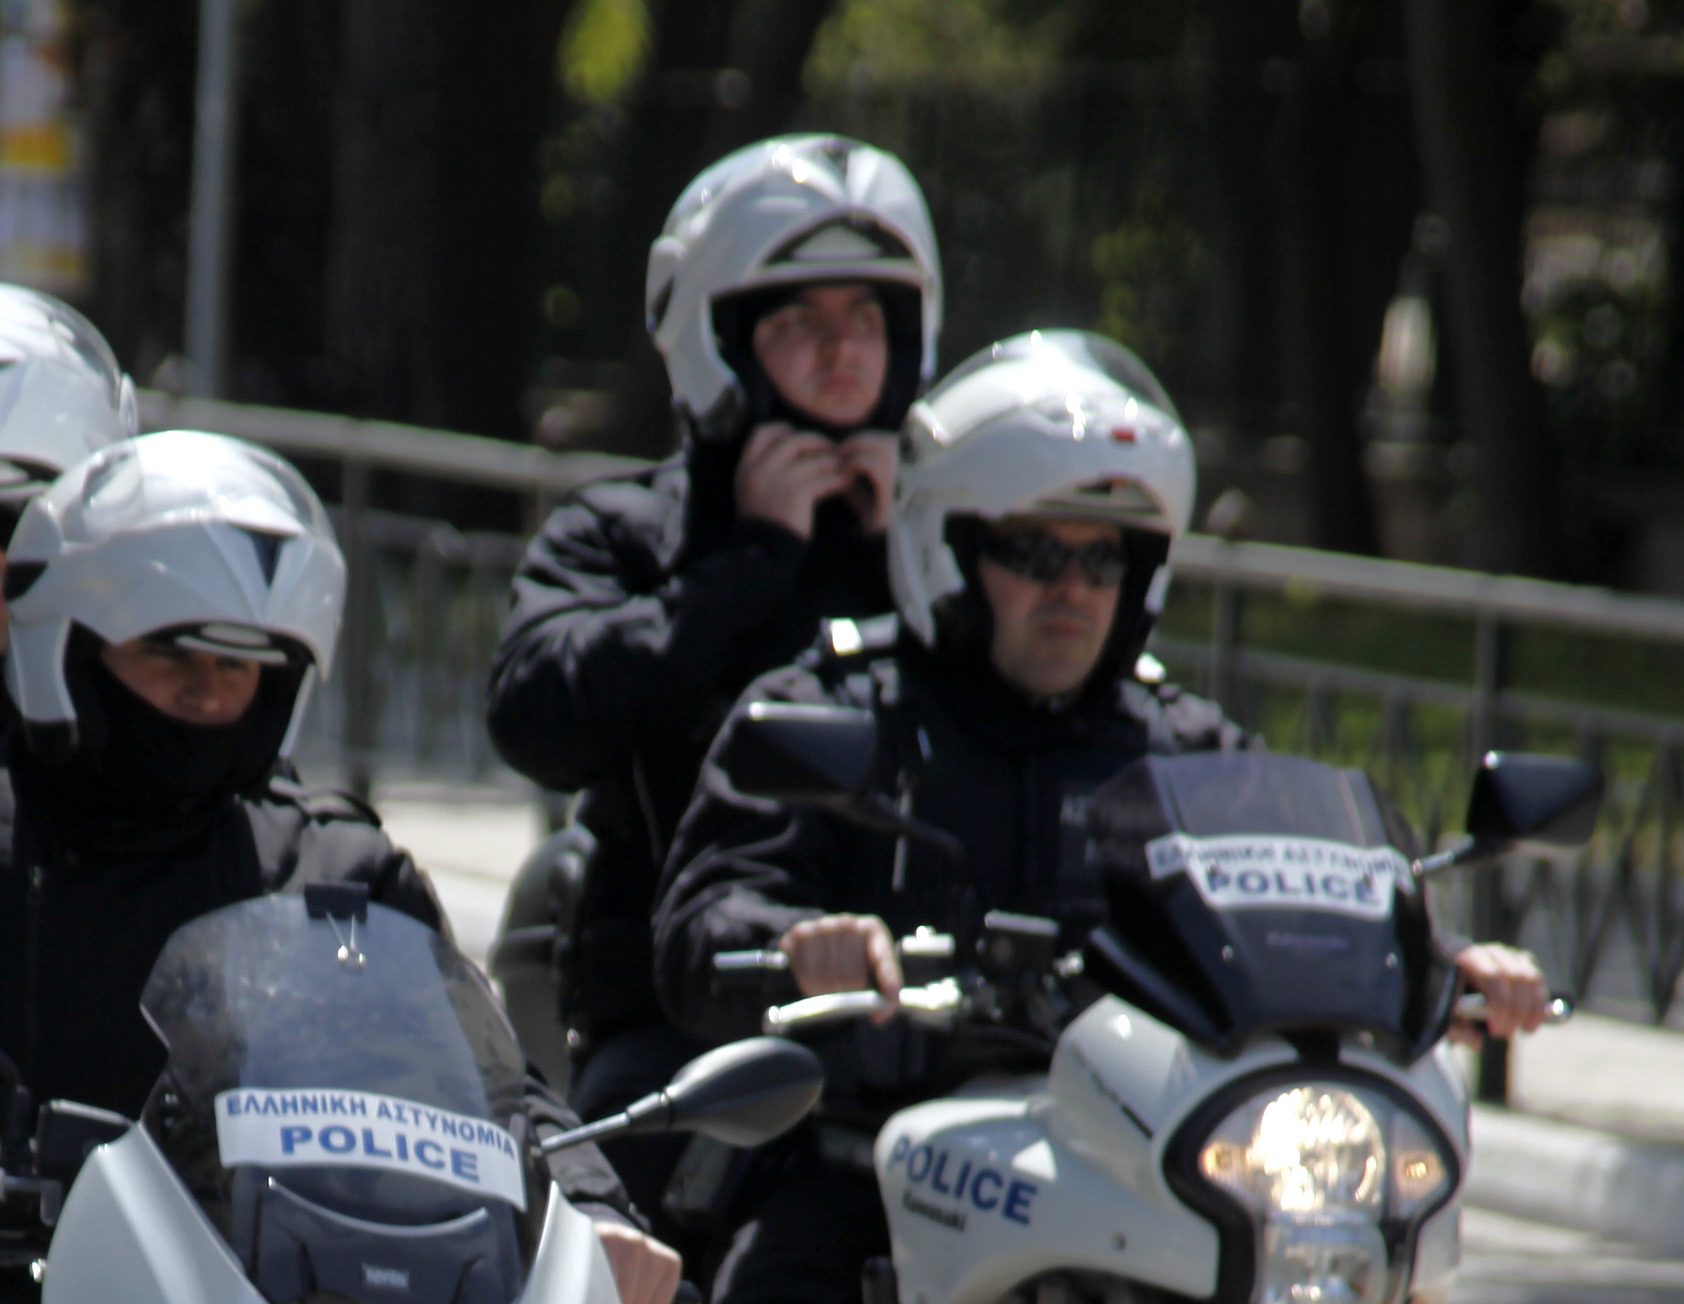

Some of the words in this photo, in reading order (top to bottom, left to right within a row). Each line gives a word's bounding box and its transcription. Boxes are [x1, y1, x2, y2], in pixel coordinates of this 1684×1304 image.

[1206, 868, 1377, 904] POLICE
[225, 1093, 367, 1117] ΕΛΛΗΝΙΚΗ
[279, 1125, 480, 1183] POLICE
[887, 1134, 1038, 1227] POLICE
